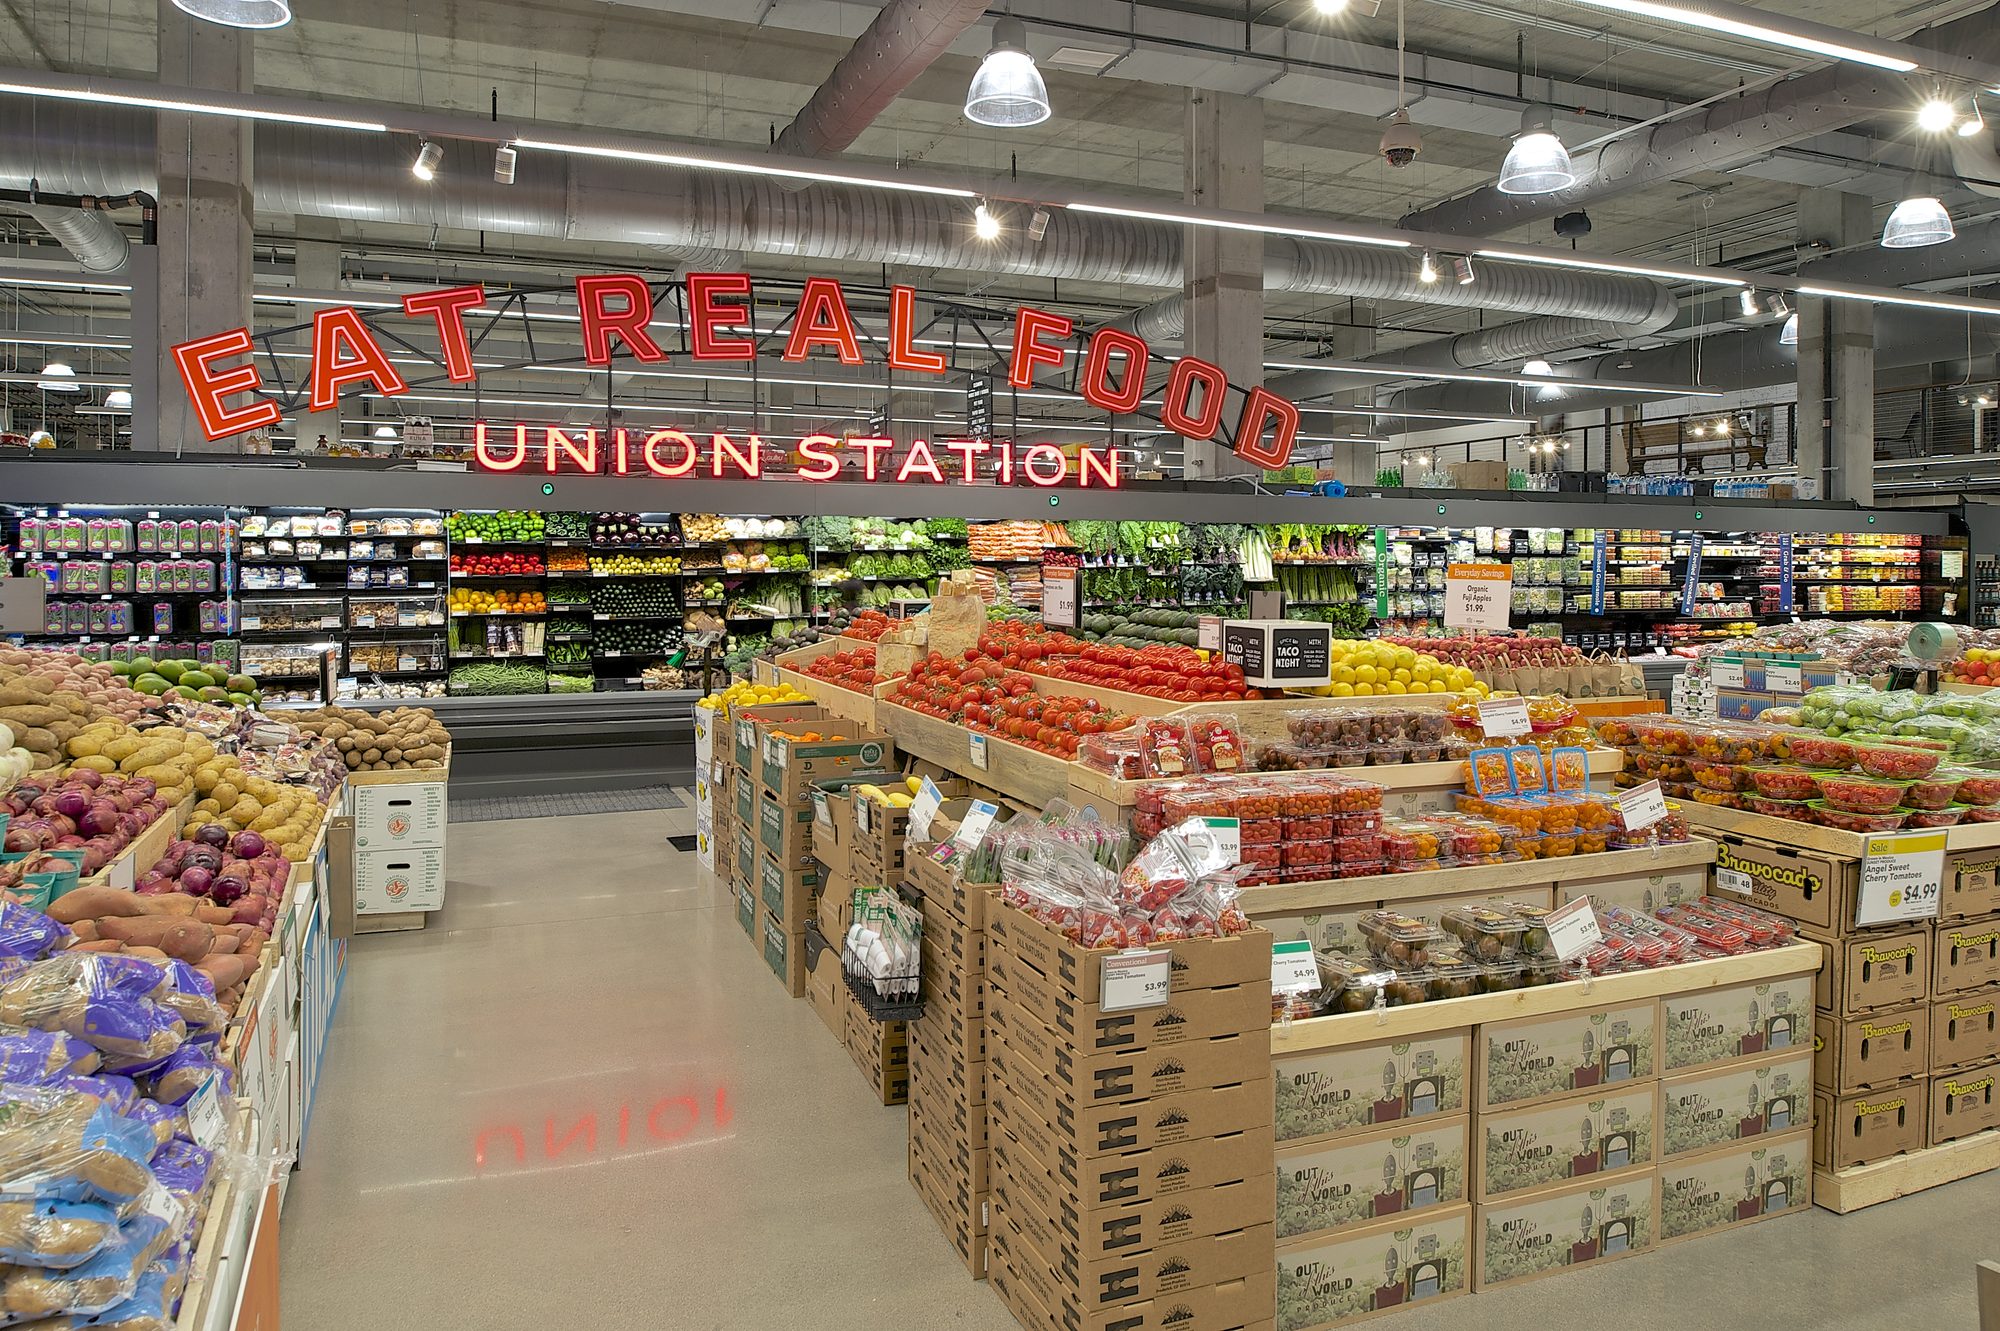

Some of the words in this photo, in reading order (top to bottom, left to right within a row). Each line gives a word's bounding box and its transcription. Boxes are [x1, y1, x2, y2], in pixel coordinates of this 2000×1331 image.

[170, 284, 487, 442] EAT
[574, 272, 947, 375] REAL
[1007, 306, 1301, 472] FOOD
[474, 421, 763, 479] UNION
[797, 434, 1121, 489] STATION
[1376, 553, 1386, 598] Organic
[1454, 568, 1481, 578] Everyday
[1481, 568, 1505, 579] Savings
[1783, 573, 1790, 583] Go
[1467, 585, 1489, 593] Organic
[1059, 600, 1073, 610] $1.99
[1462, 594, 1473, 602] Fuji
[1473, 594, 1492, 603] Apples
[1227, 643, 1243, 654] TACO
[1277, 646, 1300, 657] TACO
[1226, 653, 1244, 666] NIGHT
[1275, 658, 1300, 668] NIGHT
[1649, 801, 1664, 812] $6.99
[1220, 843, 1238, 851] $3.99
[1870, 843, 1889, 852] Sale
[1716, 842, 1823, 893] Bravocado
[1866, 864, 1887, 874] Angel
[1888, 863, 1910, 872] Sweet
[1952, 856, 2000, 875] Bravocad
[1741, 879, 1751, 889] 48
[1864, 874, 1888, 883] Cherry
[1889, 871, 1922, 881] Tomatoes
[1903, 882, 1938, 902] $4.99
[1737, 893, 1780, 910] AVOCADOS
[1580, 921, 1596, 935] $3.99
[1949, 929, 2000, 948] Bravocado
[1016, 936, 1026, 950] ALL
[1026, 942, 1046, 964] NATURAL
[1861, 943, 1917, 964] Bravocado
[1106, 958, 1148, 969] Conventional
[1293, 969, 1315, 978] $4.99
[1144, 981, 1167, 991] $3.99
[1016, 982, 1026, 996] ALL
[1026, 988, 1045, 1011] NATURAL
[1680, 1008, 1699, 1021] OUT
[1948, 1002, 1995, 1020] Bravocado
[1694, 1011, 1711, 1030] this
[1692, 1024, 1724, 1039] WORLD
[1861, 1020, 1911, 1039] Bravocado
[1015, 1028, 1025, 1043] ALL
[1025, 1036, 1043, 1060] NATURAL
[1504, 1039, 1526, 1053] OUT
[1520, 1041, 1539, 1062] this
[1518, 1056, 1555, 1072] WORLD
[1294, 1071, 1318, 1086] OUT
[1312, 1073, 1333, 1096] this
[1505, 1072, 1554, 1087] PRODUCE
[1944, 1075, 1995, 1096] Bravocado
[1016, 1074, 1025, 1089] ALL
[1025, 1083, 1045, 1110] NATURAL
[1310, 1089, 1351, 1106] WORLD
[1680, 1094, 1699, 1107] OUT
[1295, 1106, 1350, 1122] PRODUCE
[1694, 1096, 1711, 1115] this
[1855, 1098, 1906, 1117] Bravocado
[1692, 1108, 1724, 1124] WORLD
[1017, 1122, 1026, 1138] ALL
[1026, 1130, 1047, 1157] NATURAL
[1502, 1128, 1524, 1143] OUT
[1518, 1131, 1537, 1151] this
[1516, 1144, 1553, 1162] WORLD
[1295, 1167, 1319, 1182] OUT
[1503, 1161, 1553, 1177] PRODUCE
[1019, 1170, 1028, 1185] ALL
[1027, 1179, 1049, 1207] NATURAL
[1313, 1168, 1334, 1192] this
[1676, 1177, 1695, 1191] OUT
[1311, 1183, 1352, 1202] WORLD
[1690, 1180, 1707, 1199] this
[1689, 1192, 1720, 1208] WORLD
[1296, 1201, 1352, 1218] PRODUCE
[1024, 1217, 1045, 1246] ORGANIC
[1502, 1218, 1524, 1233] OUT
[1518, 1220, 1537, 1240] this
[1516, 1233, 1553, 1251] WORLD
[1502, 1249, 1551, 1266] PRODUCE
[1295, 1262, 1320, 1278] OUT
[1314, 1264, 1336, 1287] this
[1019, 1262, 1029, 1277] ALL
[1028, 1271, 1050, 1303] NATURAL
[1312, 1277, 1353, 1297] WORLD
[1296, 1295, 1352, 1314] PRODUCE
